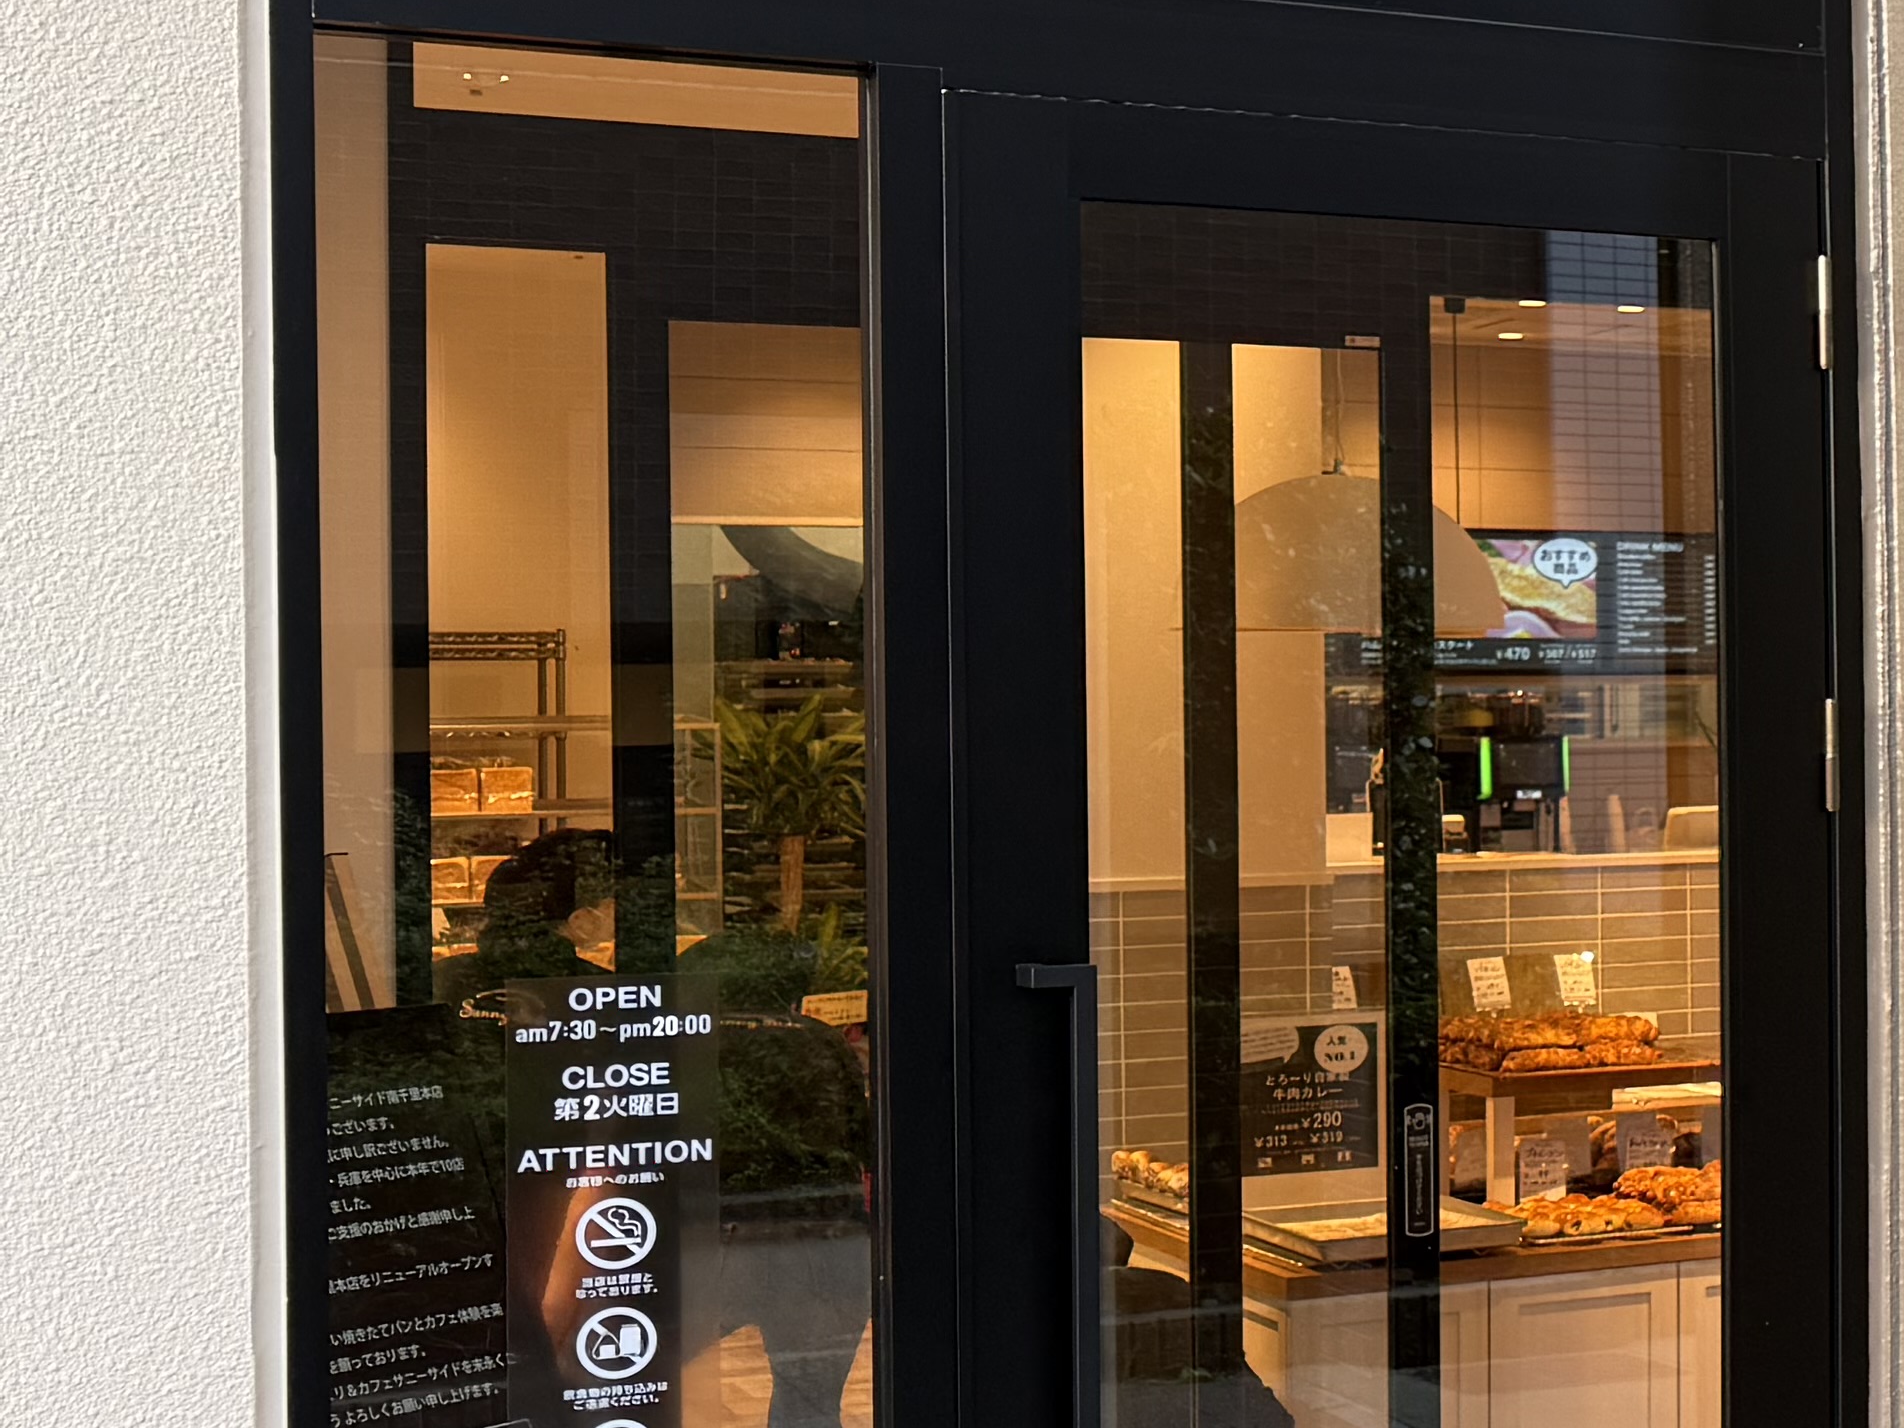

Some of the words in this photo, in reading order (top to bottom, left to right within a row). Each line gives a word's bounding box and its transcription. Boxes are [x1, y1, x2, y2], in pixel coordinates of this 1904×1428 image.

[568, 984, 662, 1012] OPEN
[561, 1062, 670, 1090] CLOSE
[554, 1092, 679, 1121] 第2火曜日
[327, 1135, 449, 1164] に申し訳ございません。
[517, 1138, 713, 1173] ATTENTION
